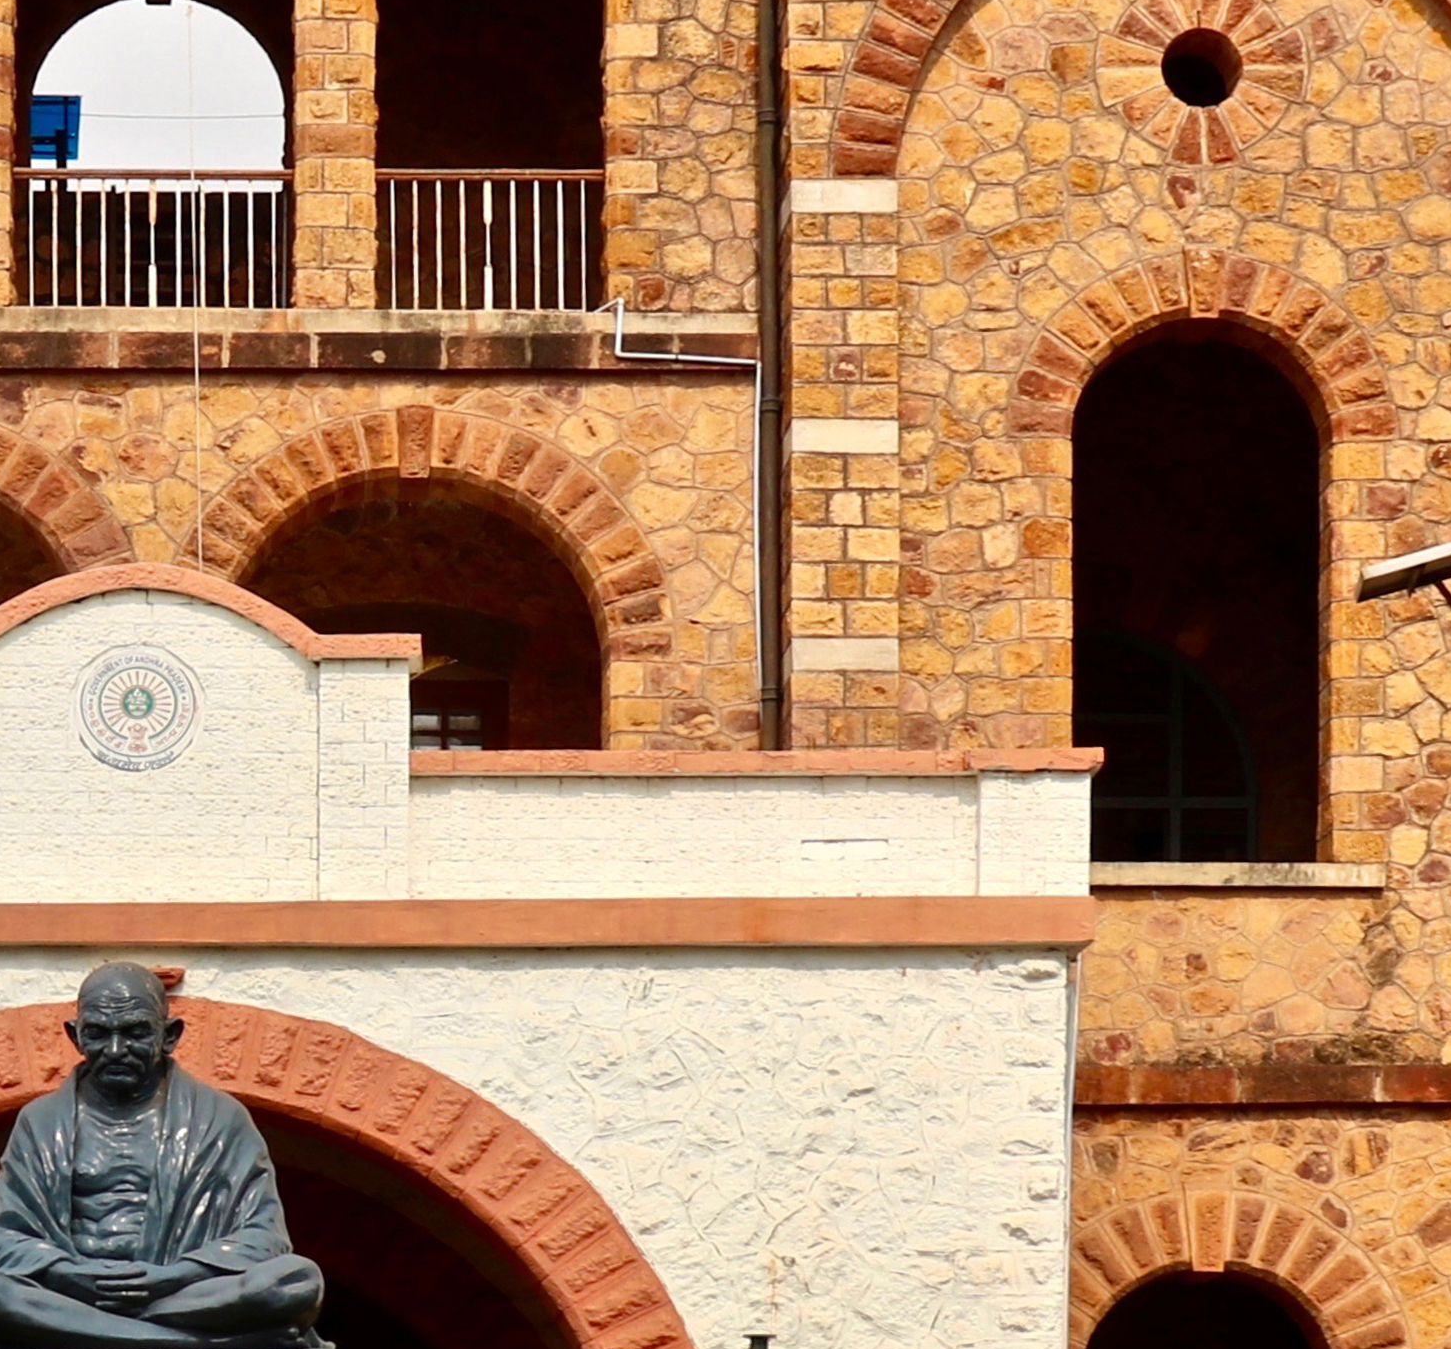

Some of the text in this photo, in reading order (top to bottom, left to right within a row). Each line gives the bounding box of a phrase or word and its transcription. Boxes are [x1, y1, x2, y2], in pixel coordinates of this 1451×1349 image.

[88, 659, 123, 695] GOVERNMENT
[123, 655, 133, 664] OF
[134, 655, 164, 668] ANDHRA
